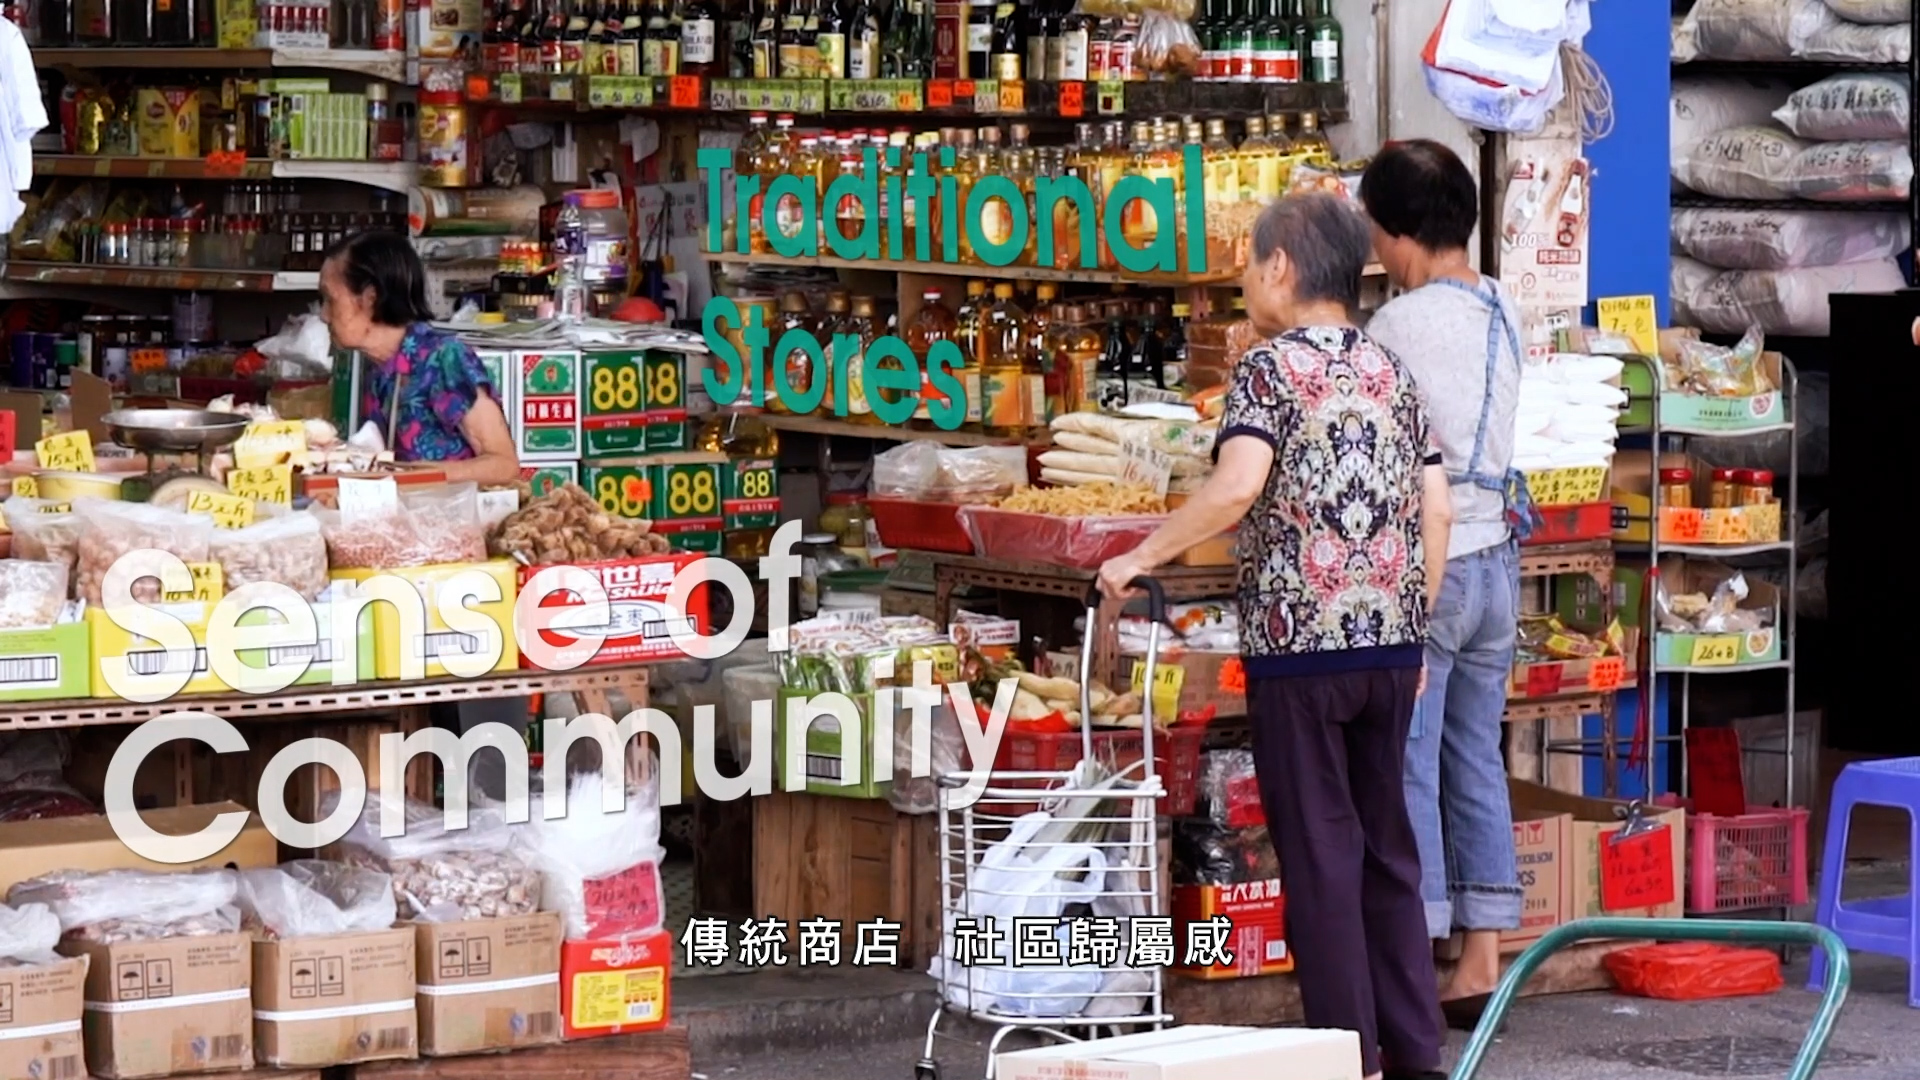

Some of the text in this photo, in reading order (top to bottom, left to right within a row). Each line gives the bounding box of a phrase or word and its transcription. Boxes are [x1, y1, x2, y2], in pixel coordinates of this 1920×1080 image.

[593, 365, 638, 410] 88
[669, 470, 714, 514] 88
[743, 471, 770, 498] 88
